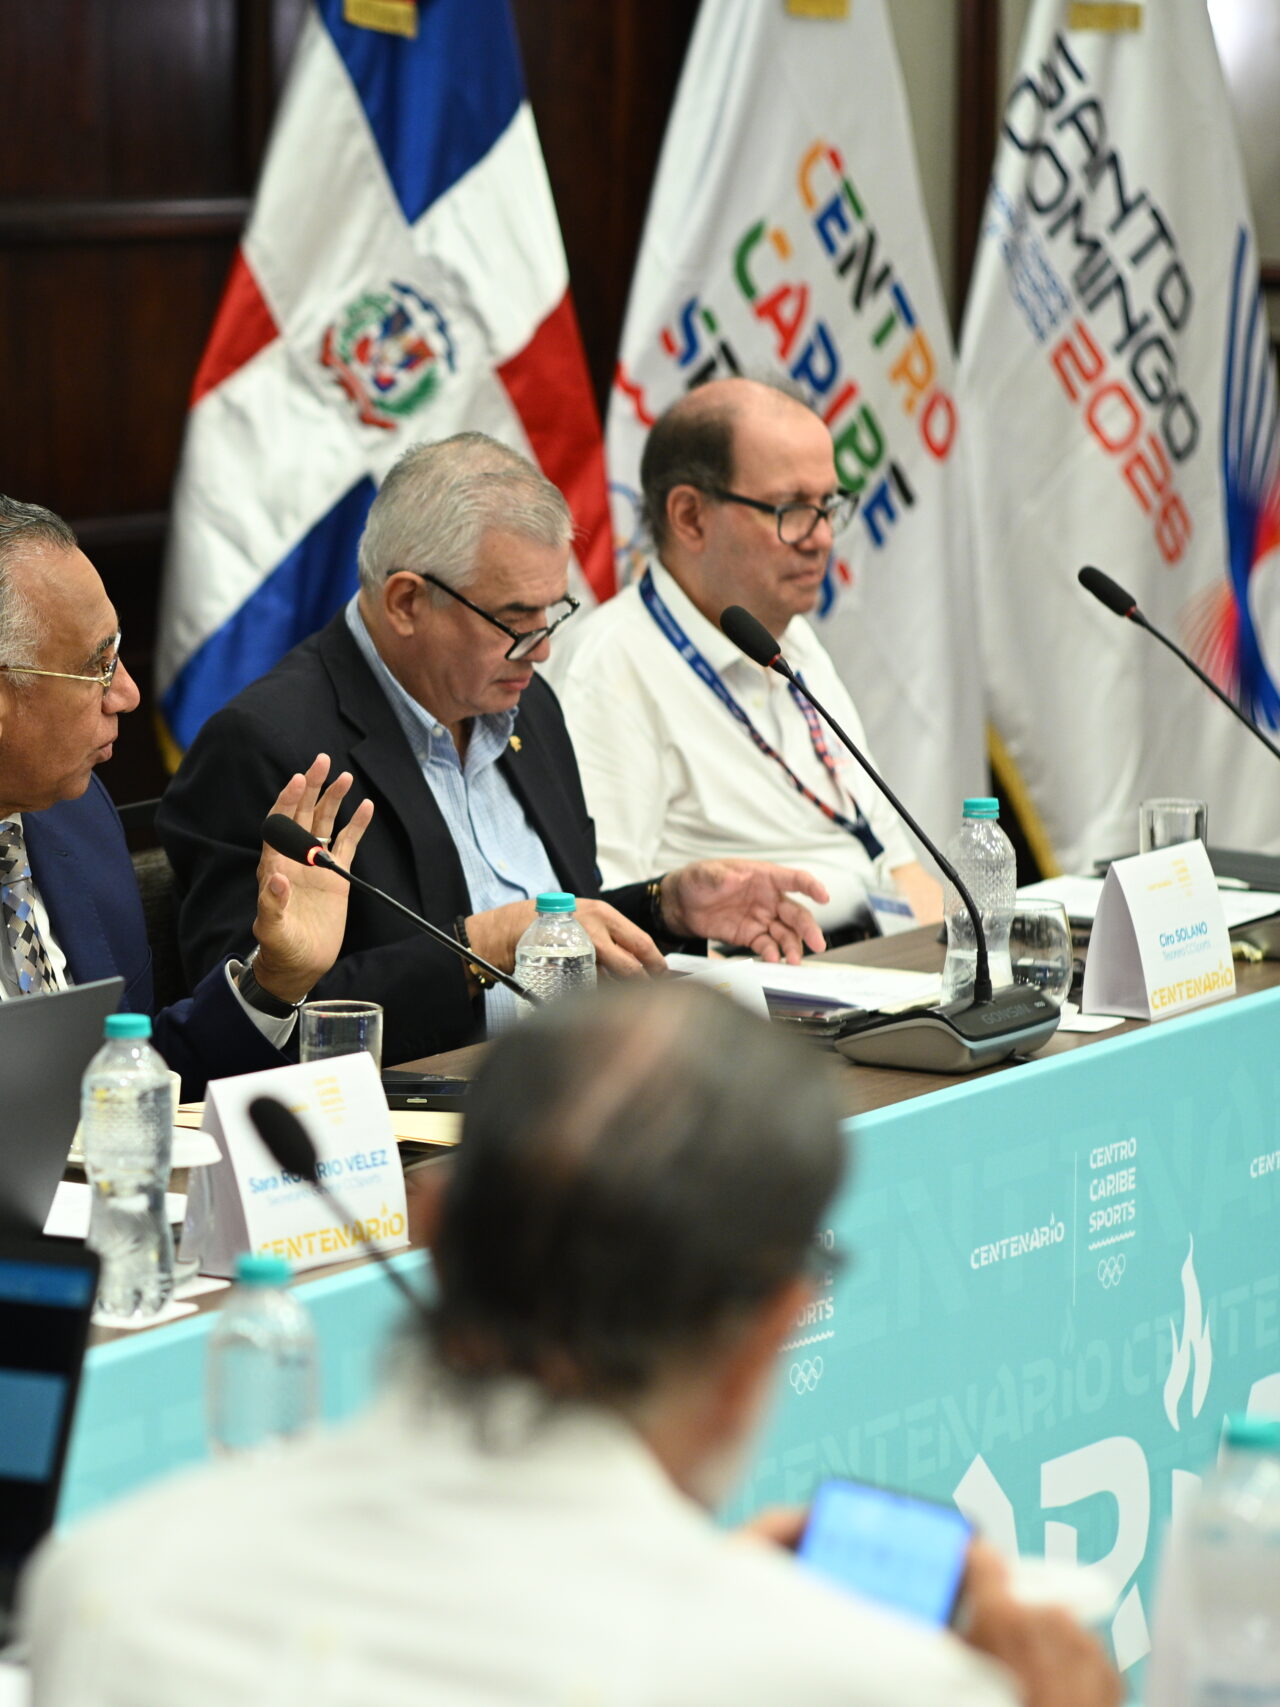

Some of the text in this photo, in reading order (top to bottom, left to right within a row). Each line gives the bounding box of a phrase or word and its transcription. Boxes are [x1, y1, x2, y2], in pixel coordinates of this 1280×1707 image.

[798, 139, 958, 464] CENTRO
[1159, 921, 1208, 948] Ciro SOLANO
[1089, 1135, 1137, 1169] CENTRO
[249, 1176, 279, 1194] Sara
[280, 1160, 343, 1186] RORIO
[1089, 1166, 1137, 1202] CARIBE
[1088, 1199, 1136, 1234] SPORTS
[795, 1296, 835, 1328] ORTS
